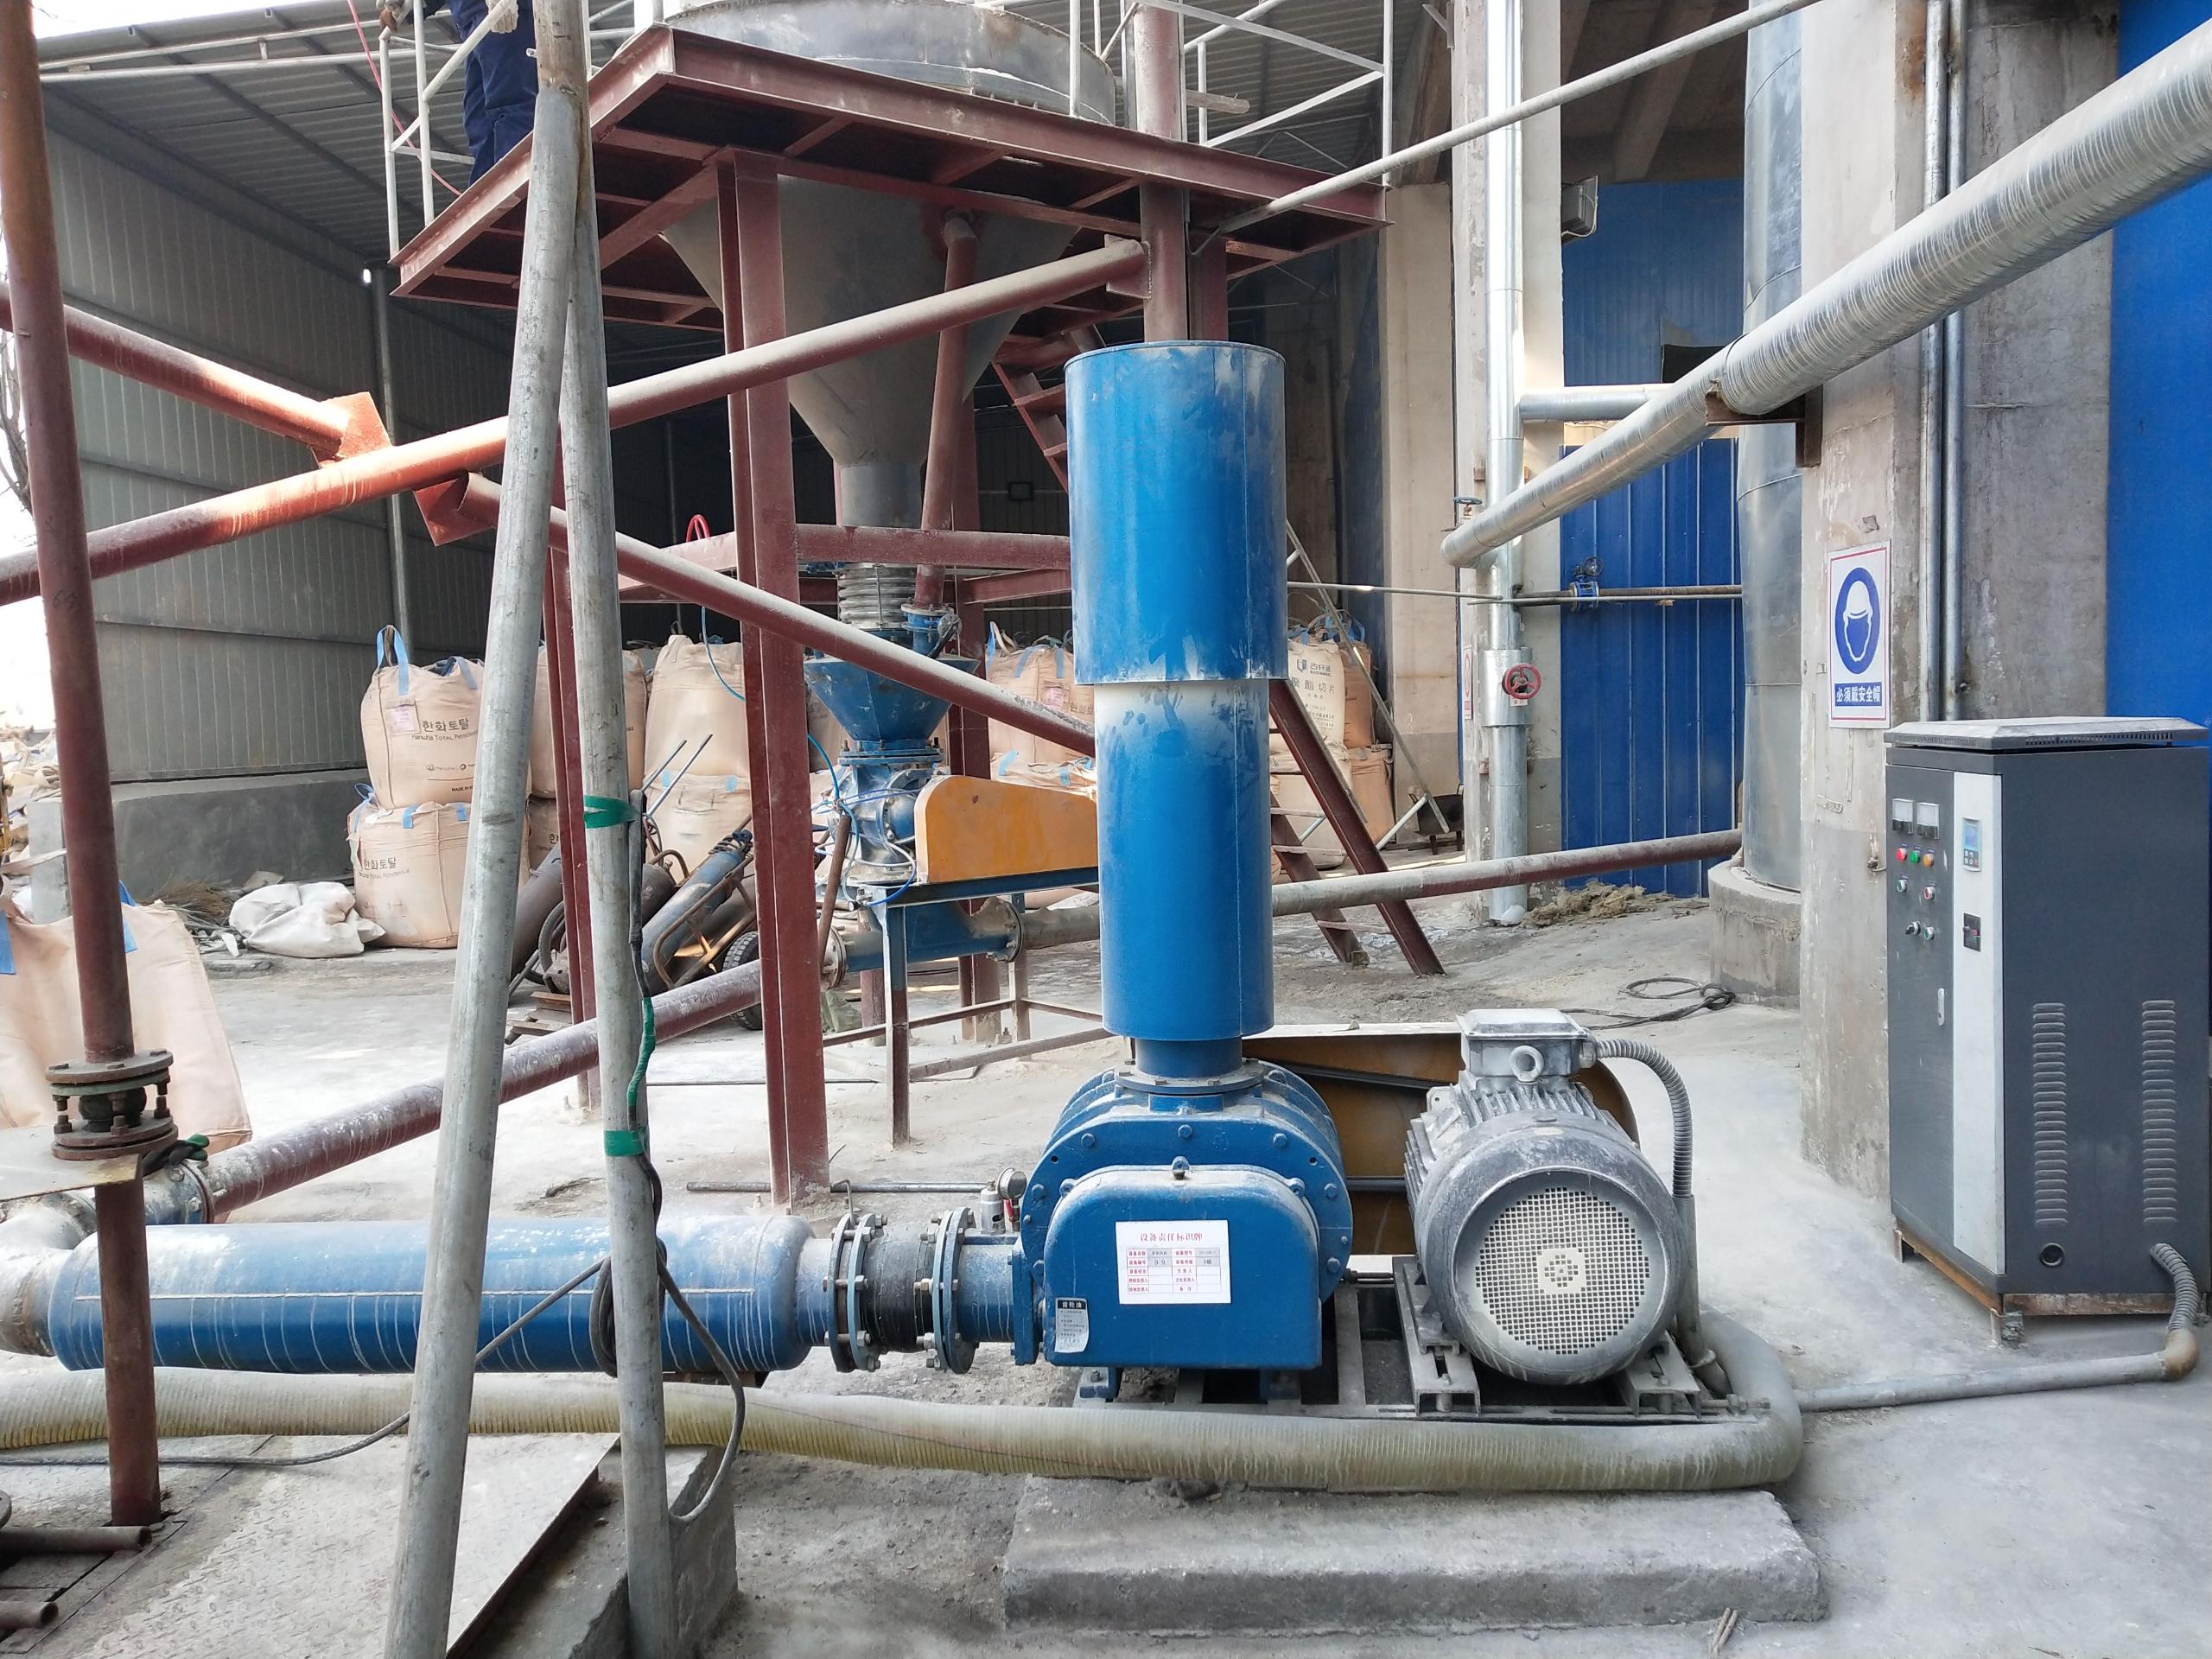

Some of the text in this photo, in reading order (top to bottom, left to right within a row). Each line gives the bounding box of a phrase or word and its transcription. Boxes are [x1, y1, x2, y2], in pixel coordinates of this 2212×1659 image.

[1836, 685, 1881, 702] 必须戴安全帽
[422, 718, 470, 733] 한화토탈
[1140, 1232, 1203, 1243] 设备责任标识牌
